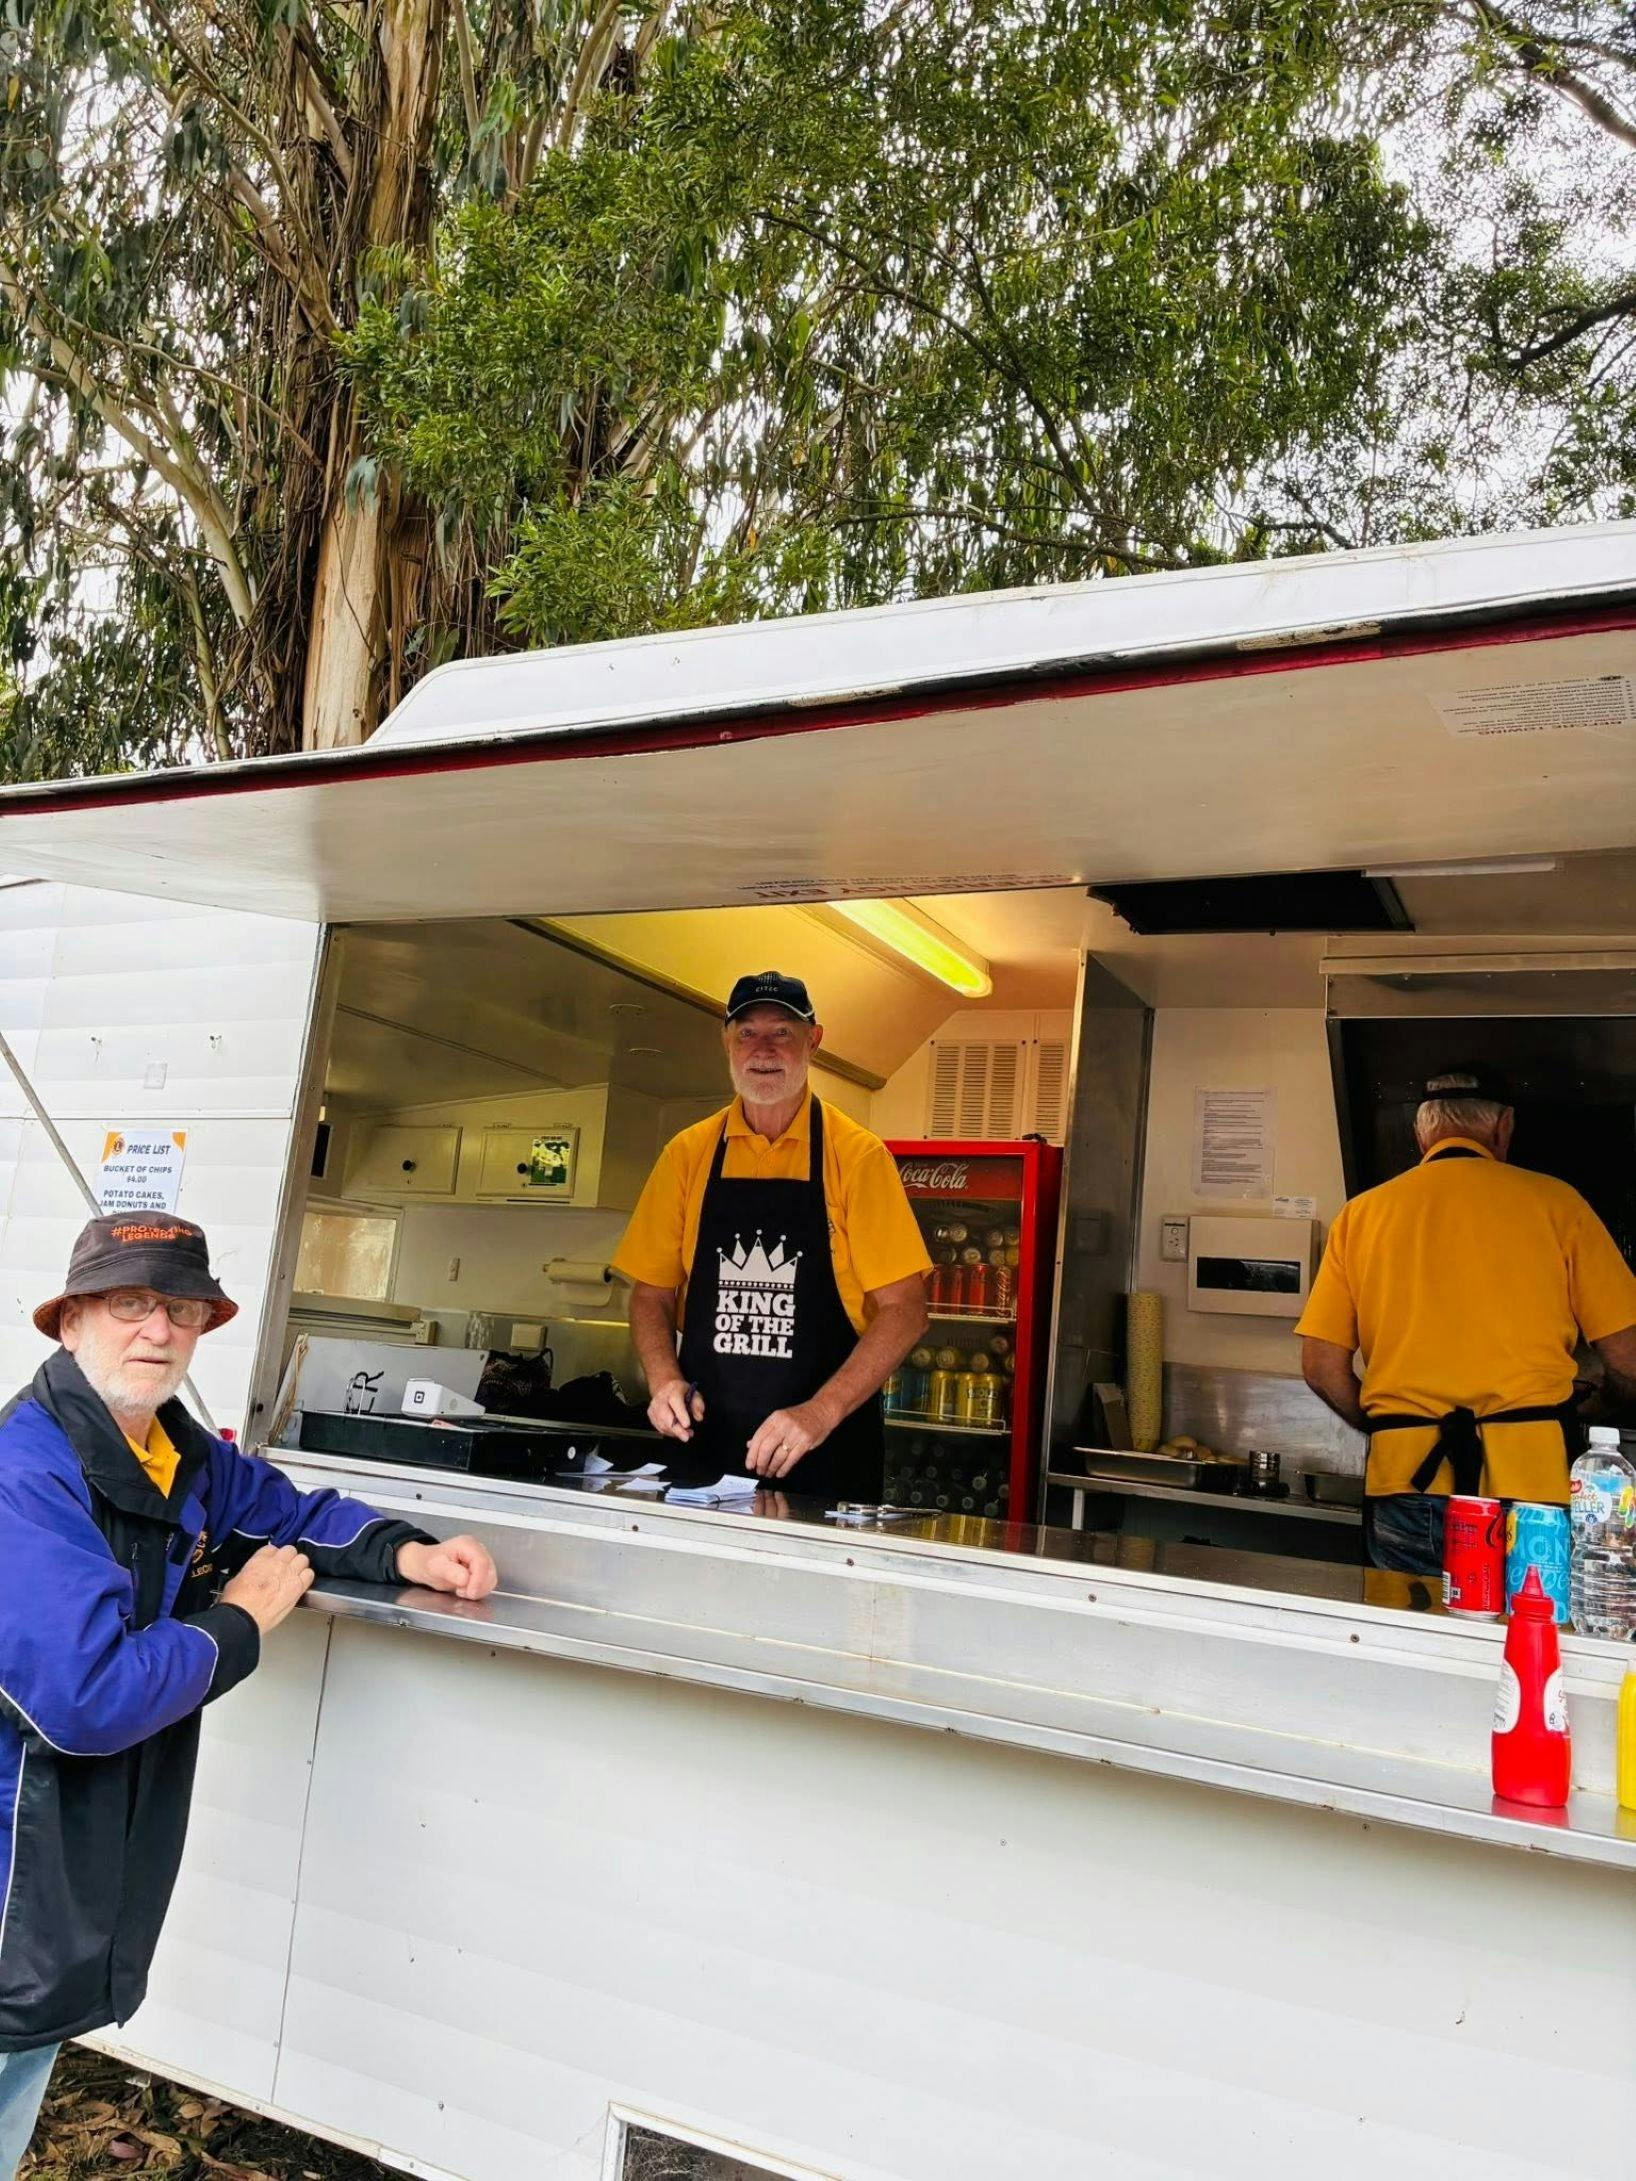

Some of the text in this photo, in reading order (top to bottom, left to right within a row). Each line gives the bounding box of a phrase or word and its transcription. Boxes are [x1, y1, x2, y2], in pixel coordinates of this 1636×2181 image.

[754, 887, 829, 898] EXIT
[127, 1144, 171, 1155] PRICE LIST
[104, 1165, 135, 1173] BUCKET
[149, 1166, 172, 1174] CHIPS
[104, 1190, 133, 1198] POTATO
[100, 1200, 114, 1208] JAM
[116, 1201, 148, 1209] DONUTS
[122, 1231, 175, 1242] LEGENDS
[716, 1289, 796, 1317] KING
[714, 1313, 795, 1337] OF THE
[713, 1332, 793, 1359] GRILL
